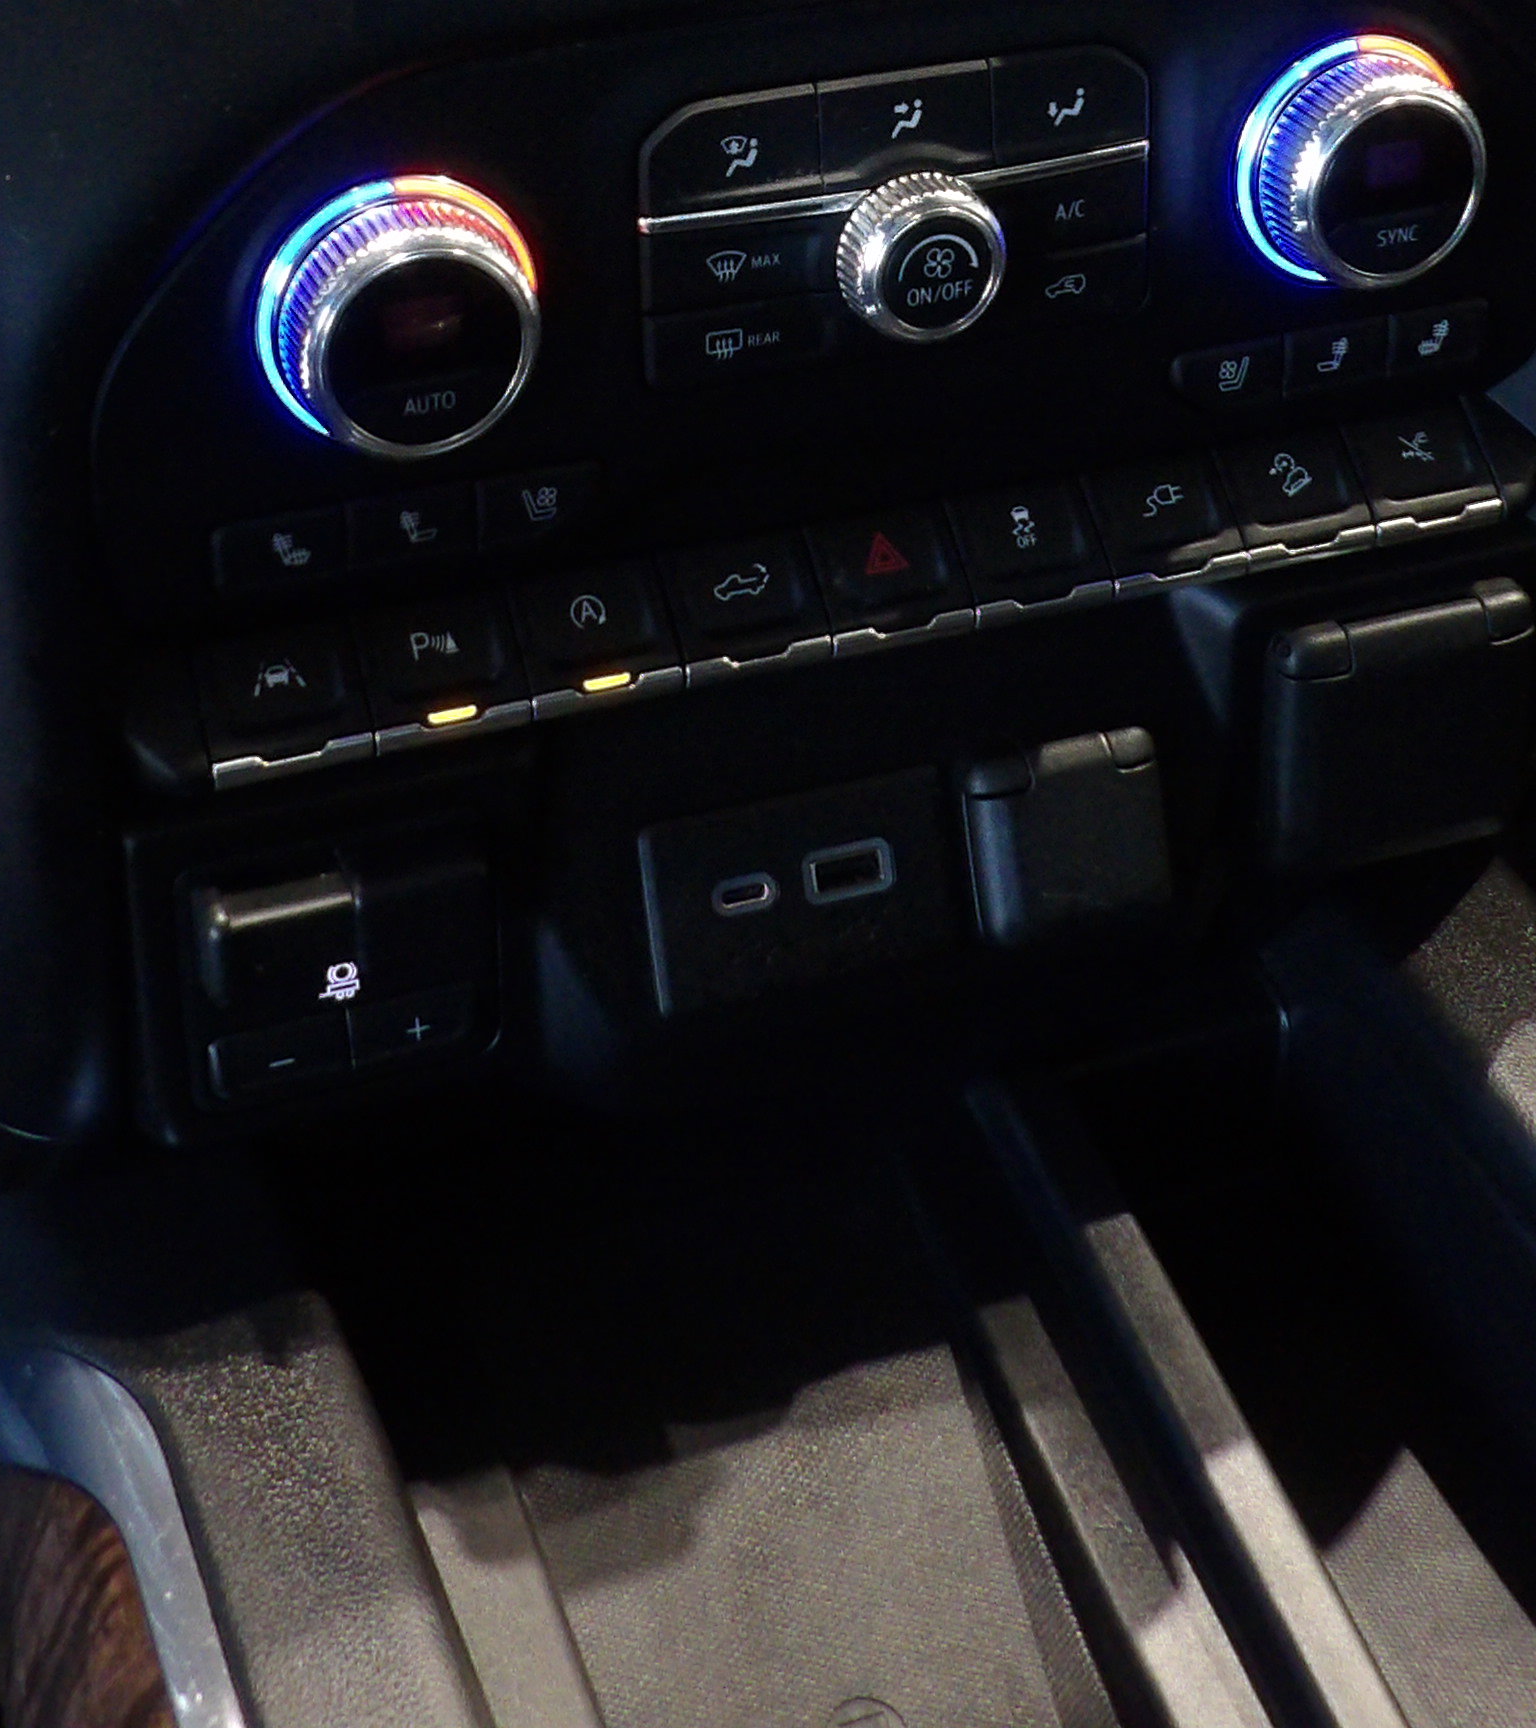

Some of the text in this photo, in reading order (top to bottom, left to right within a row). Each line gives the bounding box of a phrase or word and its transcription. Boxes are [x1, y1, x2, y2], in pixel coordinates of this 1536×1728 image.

[1054, 198, 1086, 223] A/C
[1376, 224, 1419, 248] SYNC
[750, 251, 781, 269] MAX
[906, 278, 974, 308] ON/OFF
[747, 329, 781, 347] REAR
[402, 389, 457, 417] AUTO
